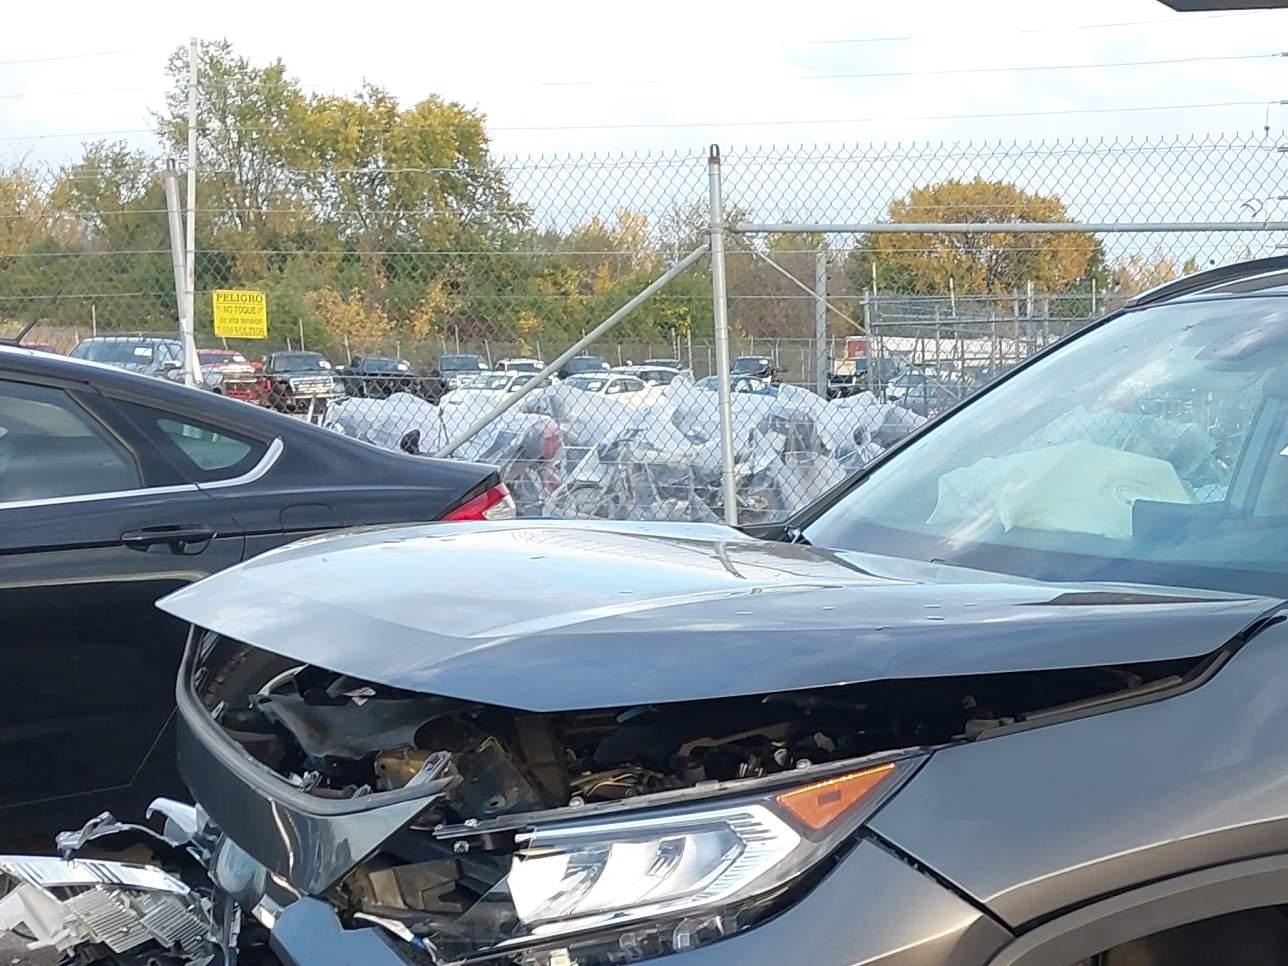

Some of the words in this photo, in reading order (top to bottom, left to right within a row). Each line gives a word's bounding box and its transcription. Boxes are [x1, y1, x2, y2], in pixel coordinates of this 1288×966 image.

[216, 293, 263, 304] PELIGRO
[223, 305, 233, 314] NO
[234, 305, 257, 315] TOQUE
[234, 327, 265, 336] VOLTIOS
